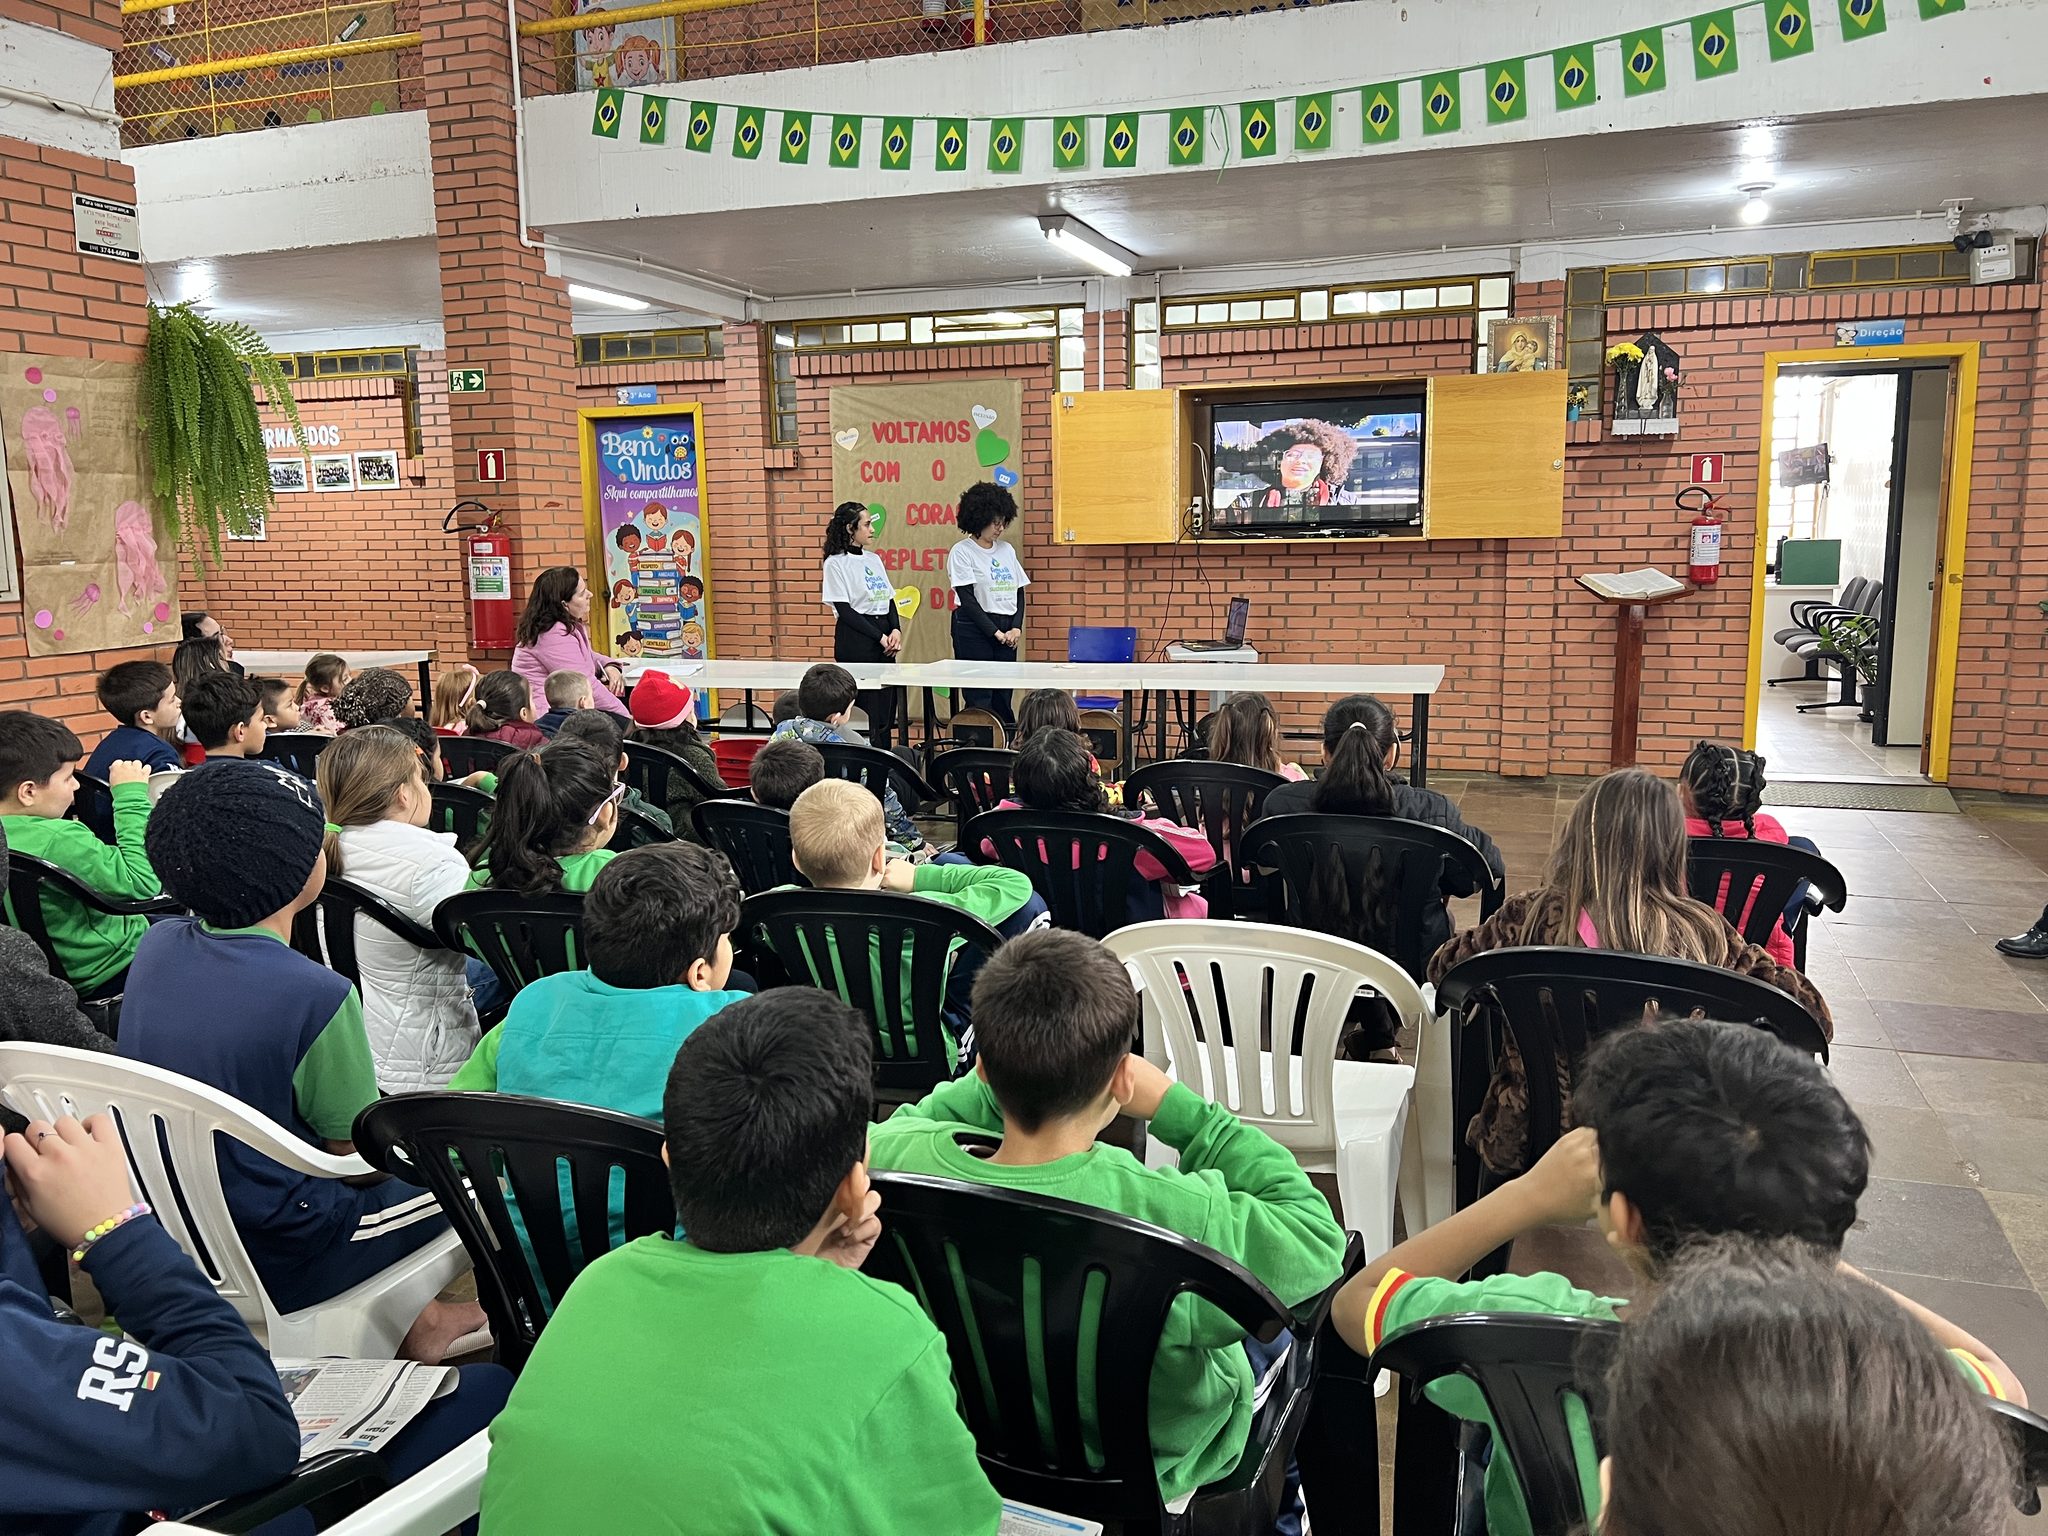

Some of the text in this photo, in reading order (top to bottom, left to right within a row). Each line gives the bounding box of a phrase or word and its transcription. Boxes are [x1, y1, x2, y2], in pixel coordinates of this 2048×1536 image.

[1859, 327, 1903, 339] Direção
[638, 391, 651, 399] Ano
[262, 425, 341, 450] RMADOS
[601, 431, 661, 457] Bem
[871, 419, 971, 444] VOLTAMOS
[617, 453, 693, 481] Vindos
[860, 459, 945, 484] COM O
[604, 484, 699, 503] Aqui compartilhamos
[906, 503, 959, 526] CORA
[874, 548, 950, 571] REPLET
[77, 1336, 149, 1412] RS
